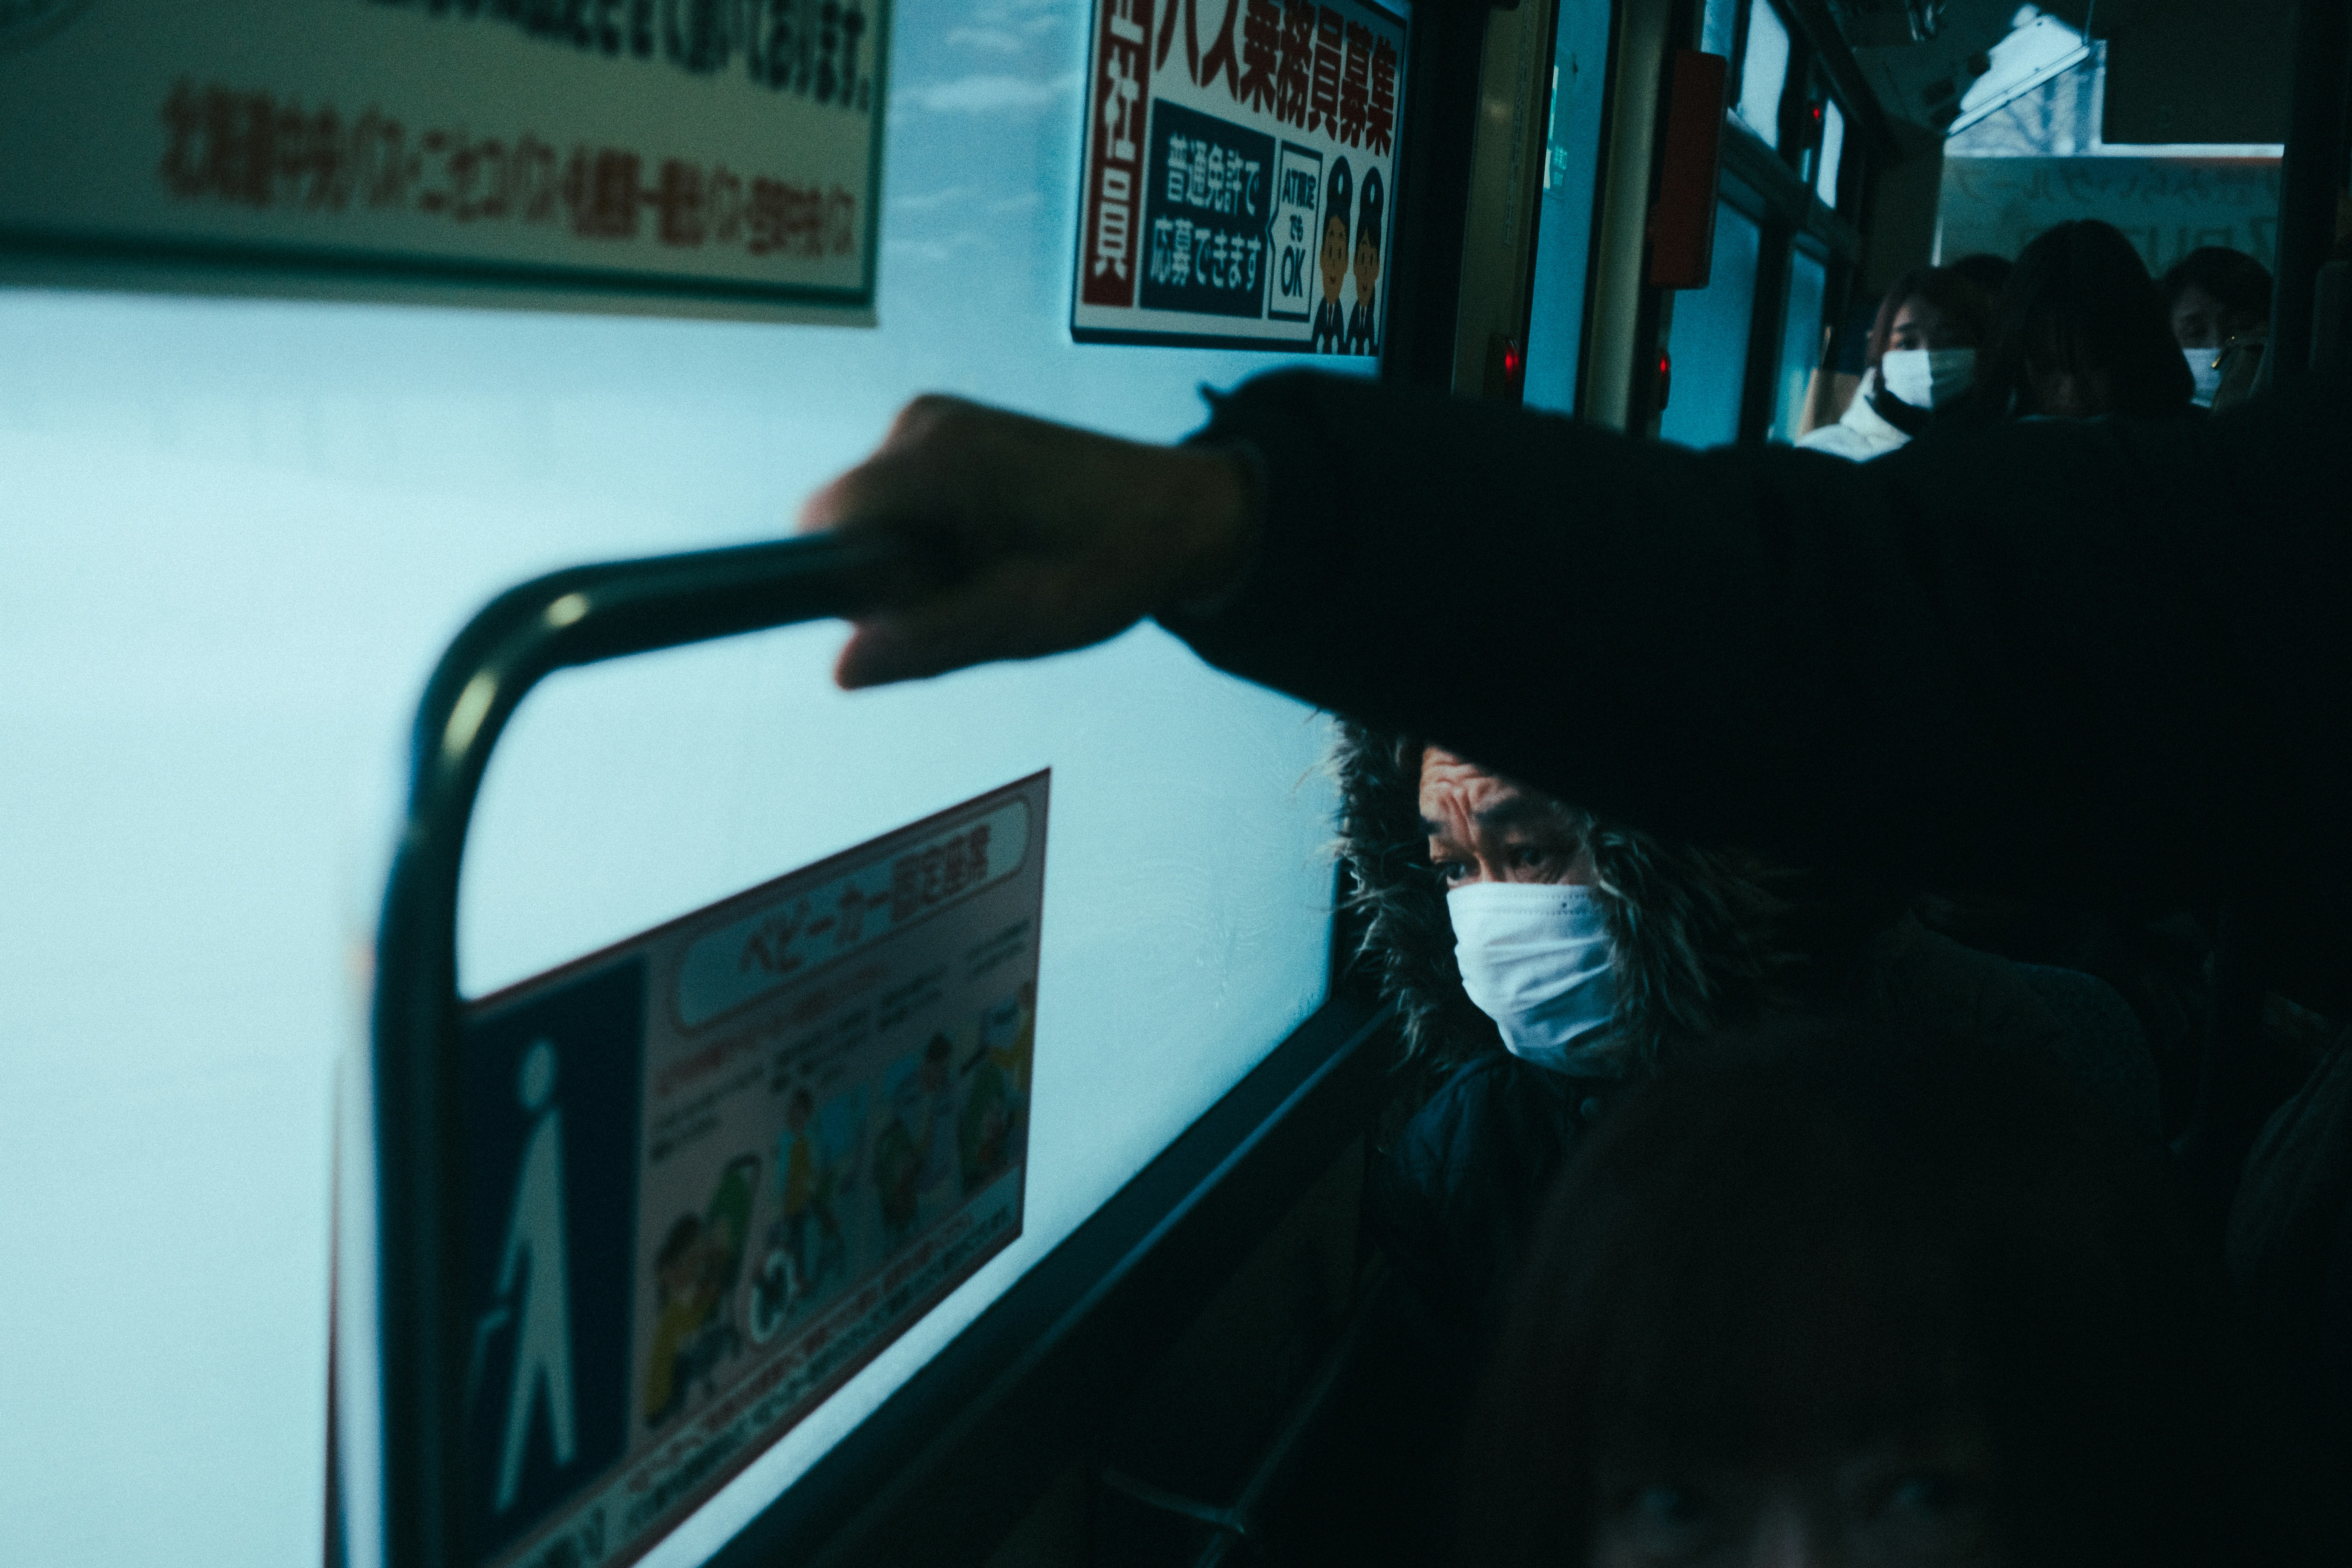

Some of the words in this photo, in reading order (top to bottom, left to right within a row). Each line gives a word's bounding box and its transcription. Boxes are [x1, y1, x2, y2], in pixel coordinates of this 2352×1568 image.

[1168, 133, 1260, 216] 普通免許で
[1150, 213, 1261, 292] 応募できます
[1282, 245, 1306, 297] OK
